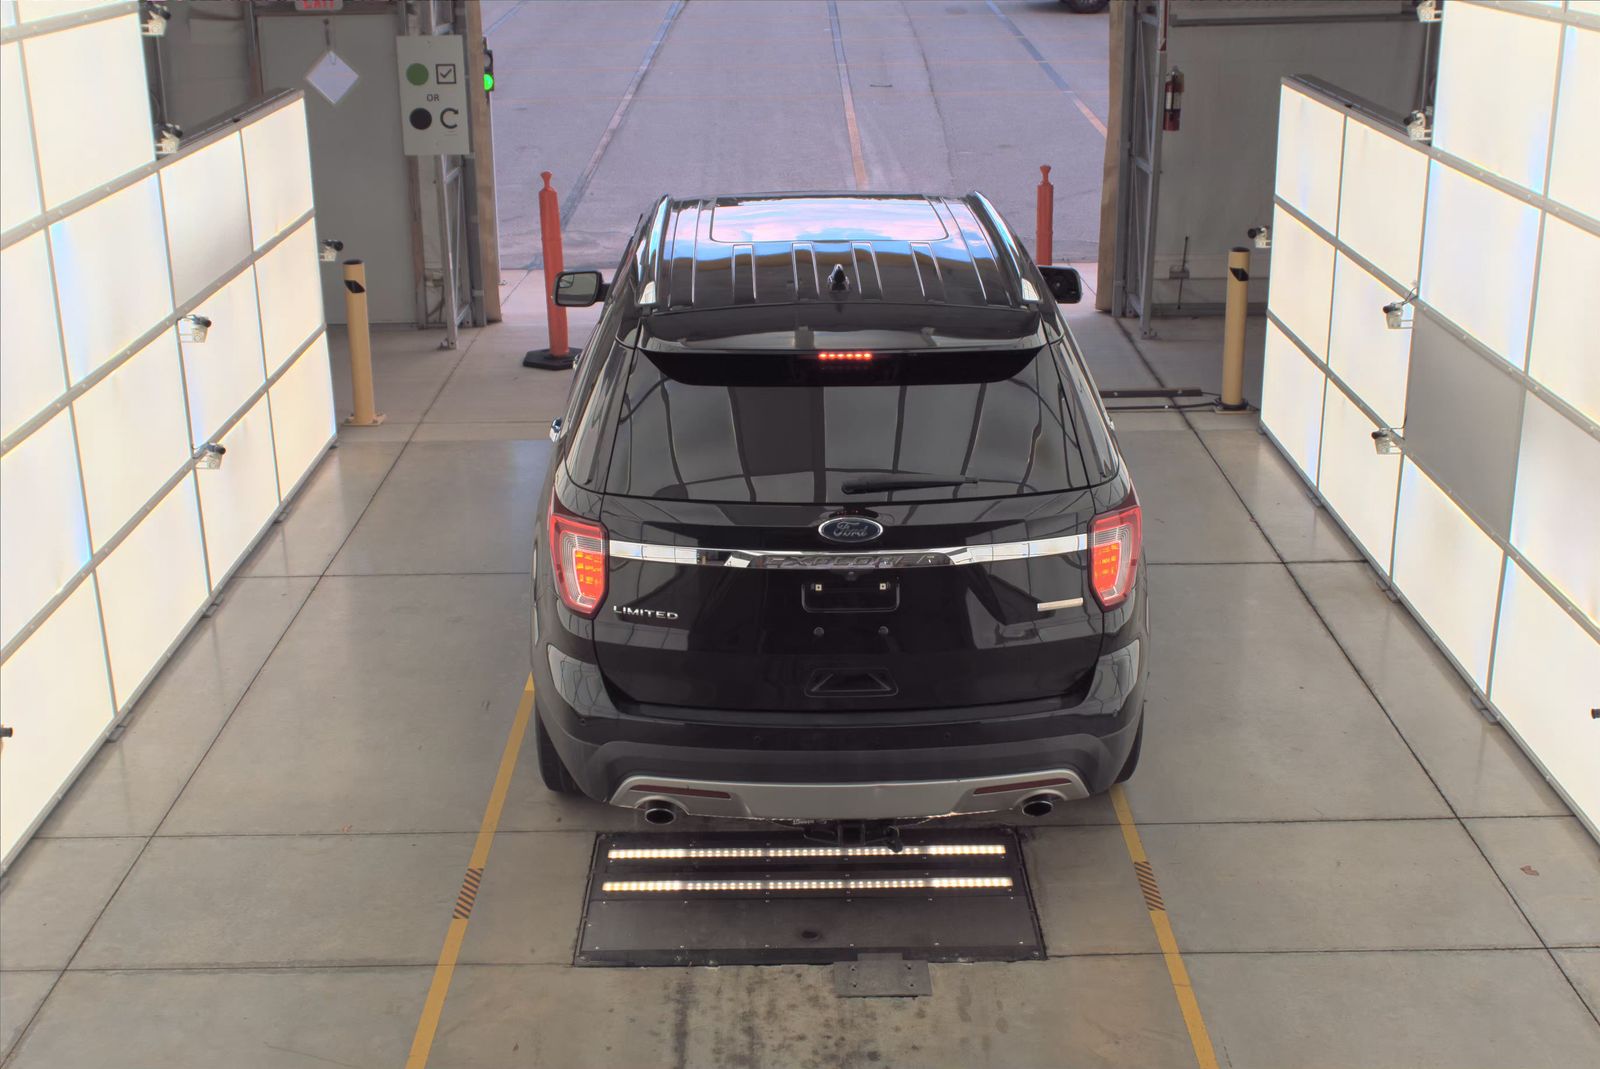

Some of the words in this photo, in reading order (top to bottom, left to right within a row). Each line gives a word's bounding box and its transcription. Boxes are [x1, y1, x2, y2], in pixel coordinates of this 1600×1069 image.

[426, 93, 440, 102] OR
[832, 520, 868, 537] Ford
[613, 605, 679, 619] LIMITED
